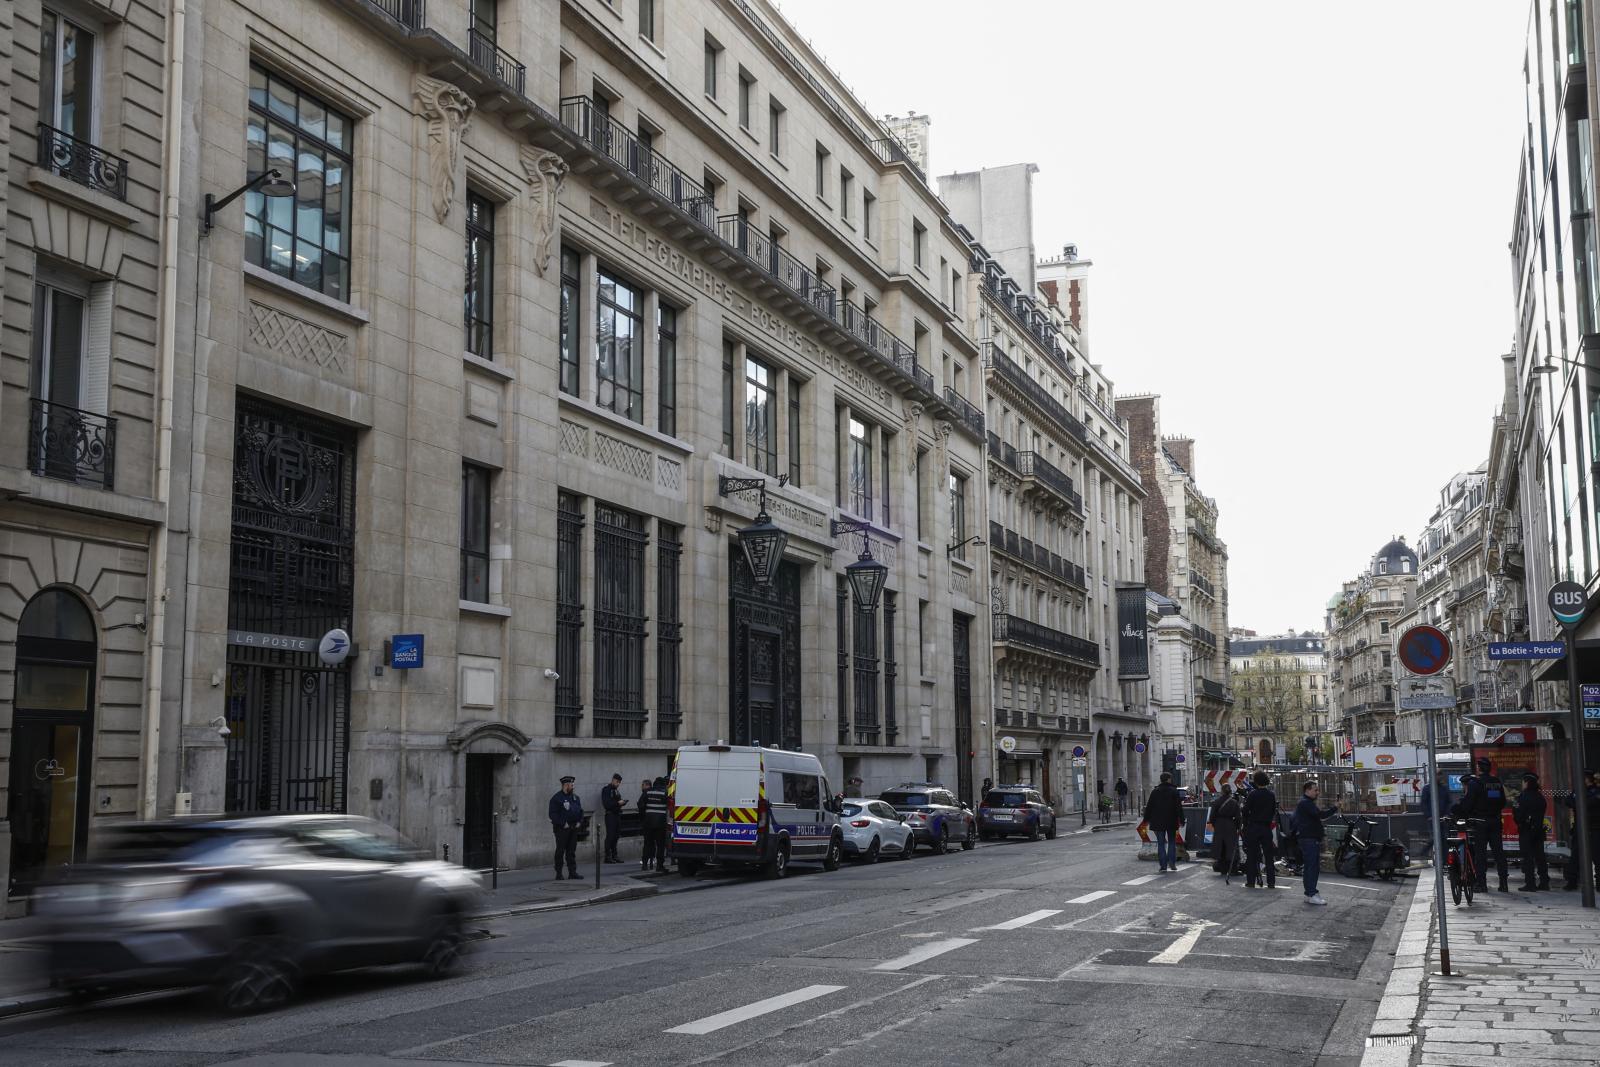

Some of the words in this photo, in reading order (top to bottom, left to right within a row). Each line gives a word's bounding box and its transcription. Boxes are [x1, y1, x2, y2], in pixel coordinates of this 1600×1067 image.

[751, 303, 803, 352] POSTES
[1554, 591, 1582, 605] BUS
[236, 633, 254, 643] LA
[262, 636, 305, 649] POSTE
[1490, 647, 1500, 655] La
[1502, 646, 1528, 655] Boétie
[1533, 645, 1562, 654] Percier
[1586, 708, 1600, 718] 52
[797, 825, 816, 836] POLICE
